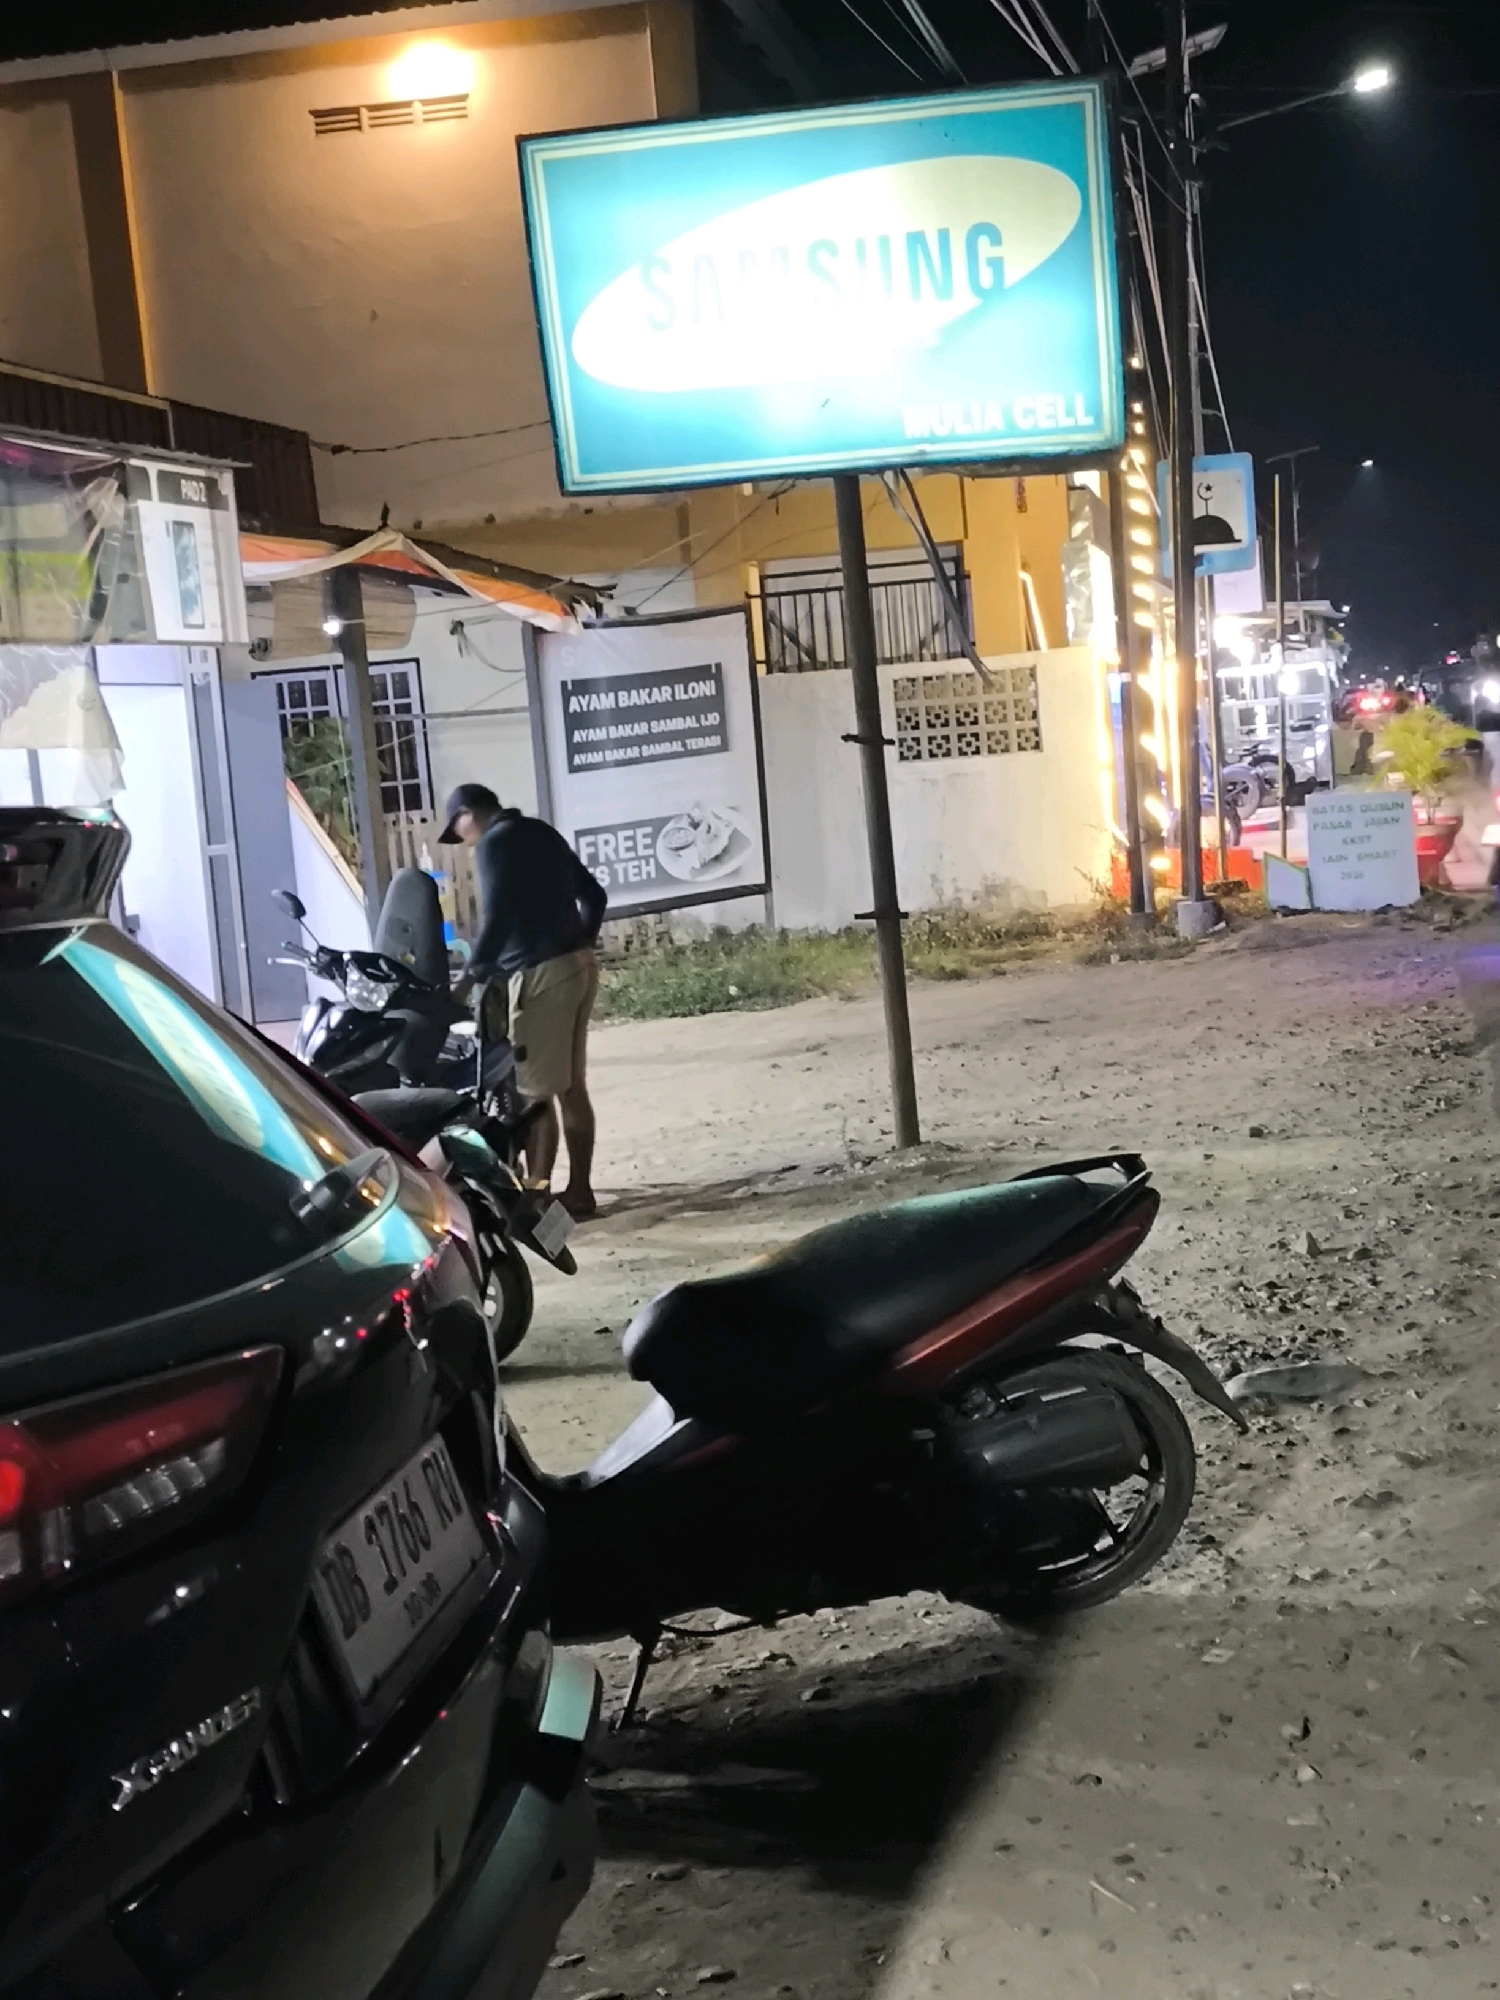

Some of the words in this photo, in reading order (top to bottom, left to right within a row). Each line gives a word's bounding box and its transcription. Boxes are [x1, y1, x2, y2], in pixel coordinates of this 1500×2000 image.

[902, 398, 1005, 439] MULIA
[1013, 392, 1095, 430] CELL
[568, 692, 616, 713] AYAM
[618, 686, 673, 708] BAKAR
[674, 679, 717, 700] ILONI
[572, 726, 607, 743] AYAM
[609, 721, 649, 739] BAKAR
[650, 715, 700, 733] SAMBAL
[701, 712, 720, 727] IJO
[573, 751, 604, 766] AYAM
[604, 746, 640, 762] BAKAR
[641, 740, 685, 757] SAMBAL
[685, 734, 722, 750] TERASI
[578, 826, 654, 866] FREE
[613, 857, 657, 884] TEH
[317, 1541, 372, 1640] DB
[363, 1474, 432, 1597] 1766
